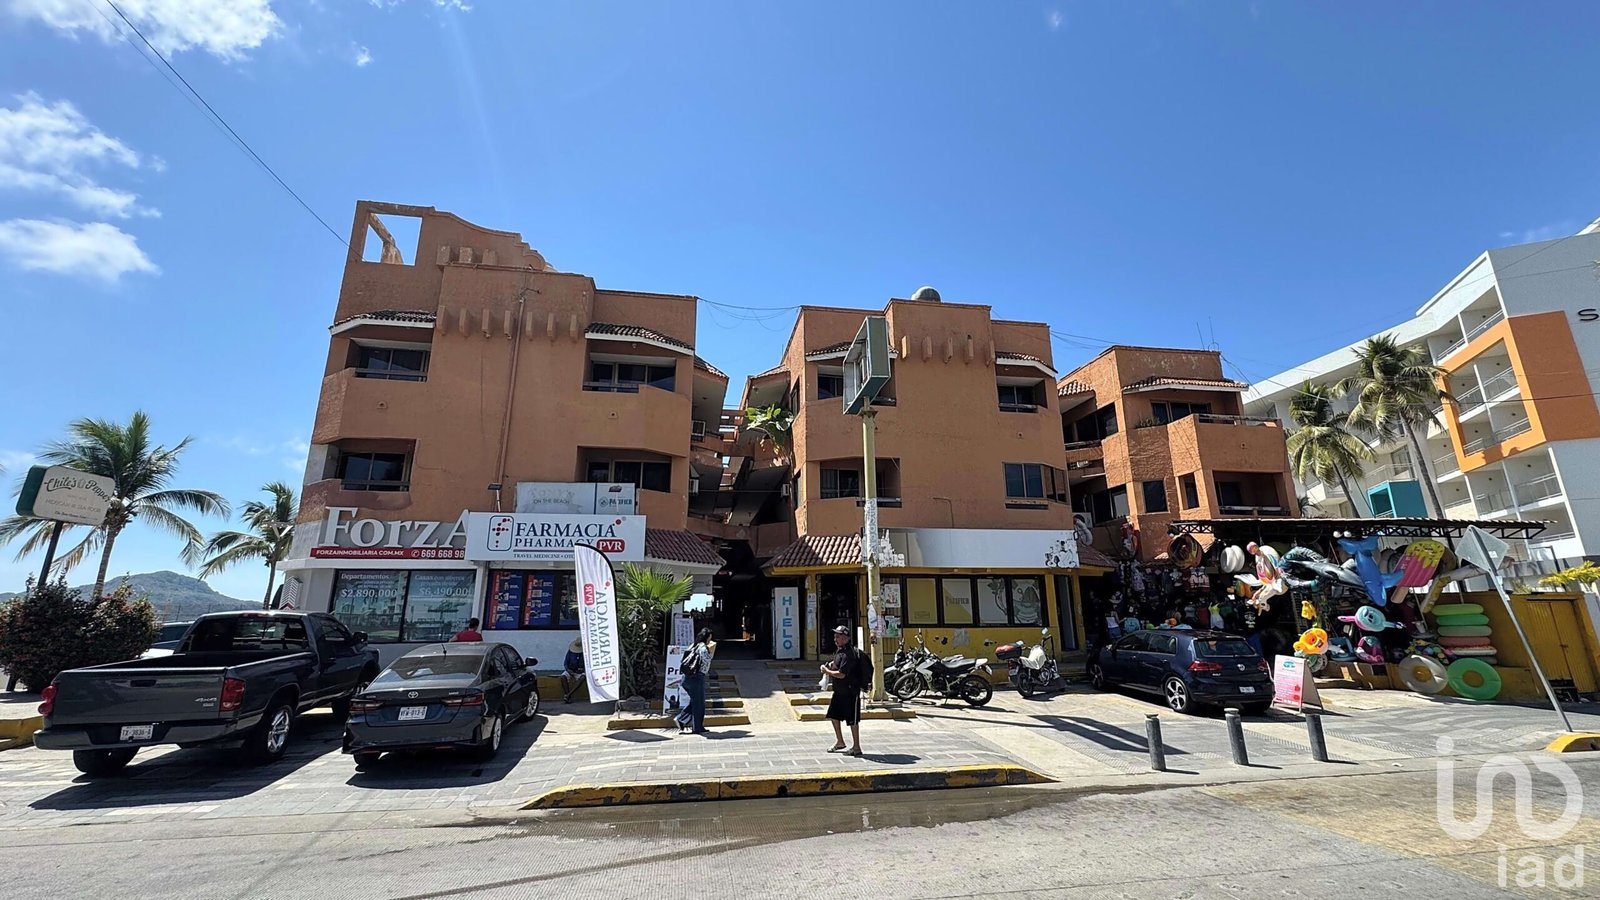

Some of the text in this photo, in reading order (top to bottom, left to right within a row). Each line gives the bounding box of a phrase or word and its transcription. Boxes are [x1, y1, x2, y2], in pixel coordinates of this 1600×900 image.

[44, 476, 77, 492] Chile's
[515, 522, 617, 538] FARMACIA
[599, 541, 623, 551] PVR
[421, 549, 436, 558] 669
[438, 549, 453, 558] 668
[341, 573, 390, 581] Departamentos
[782, 596, 793, 650] HIELO
